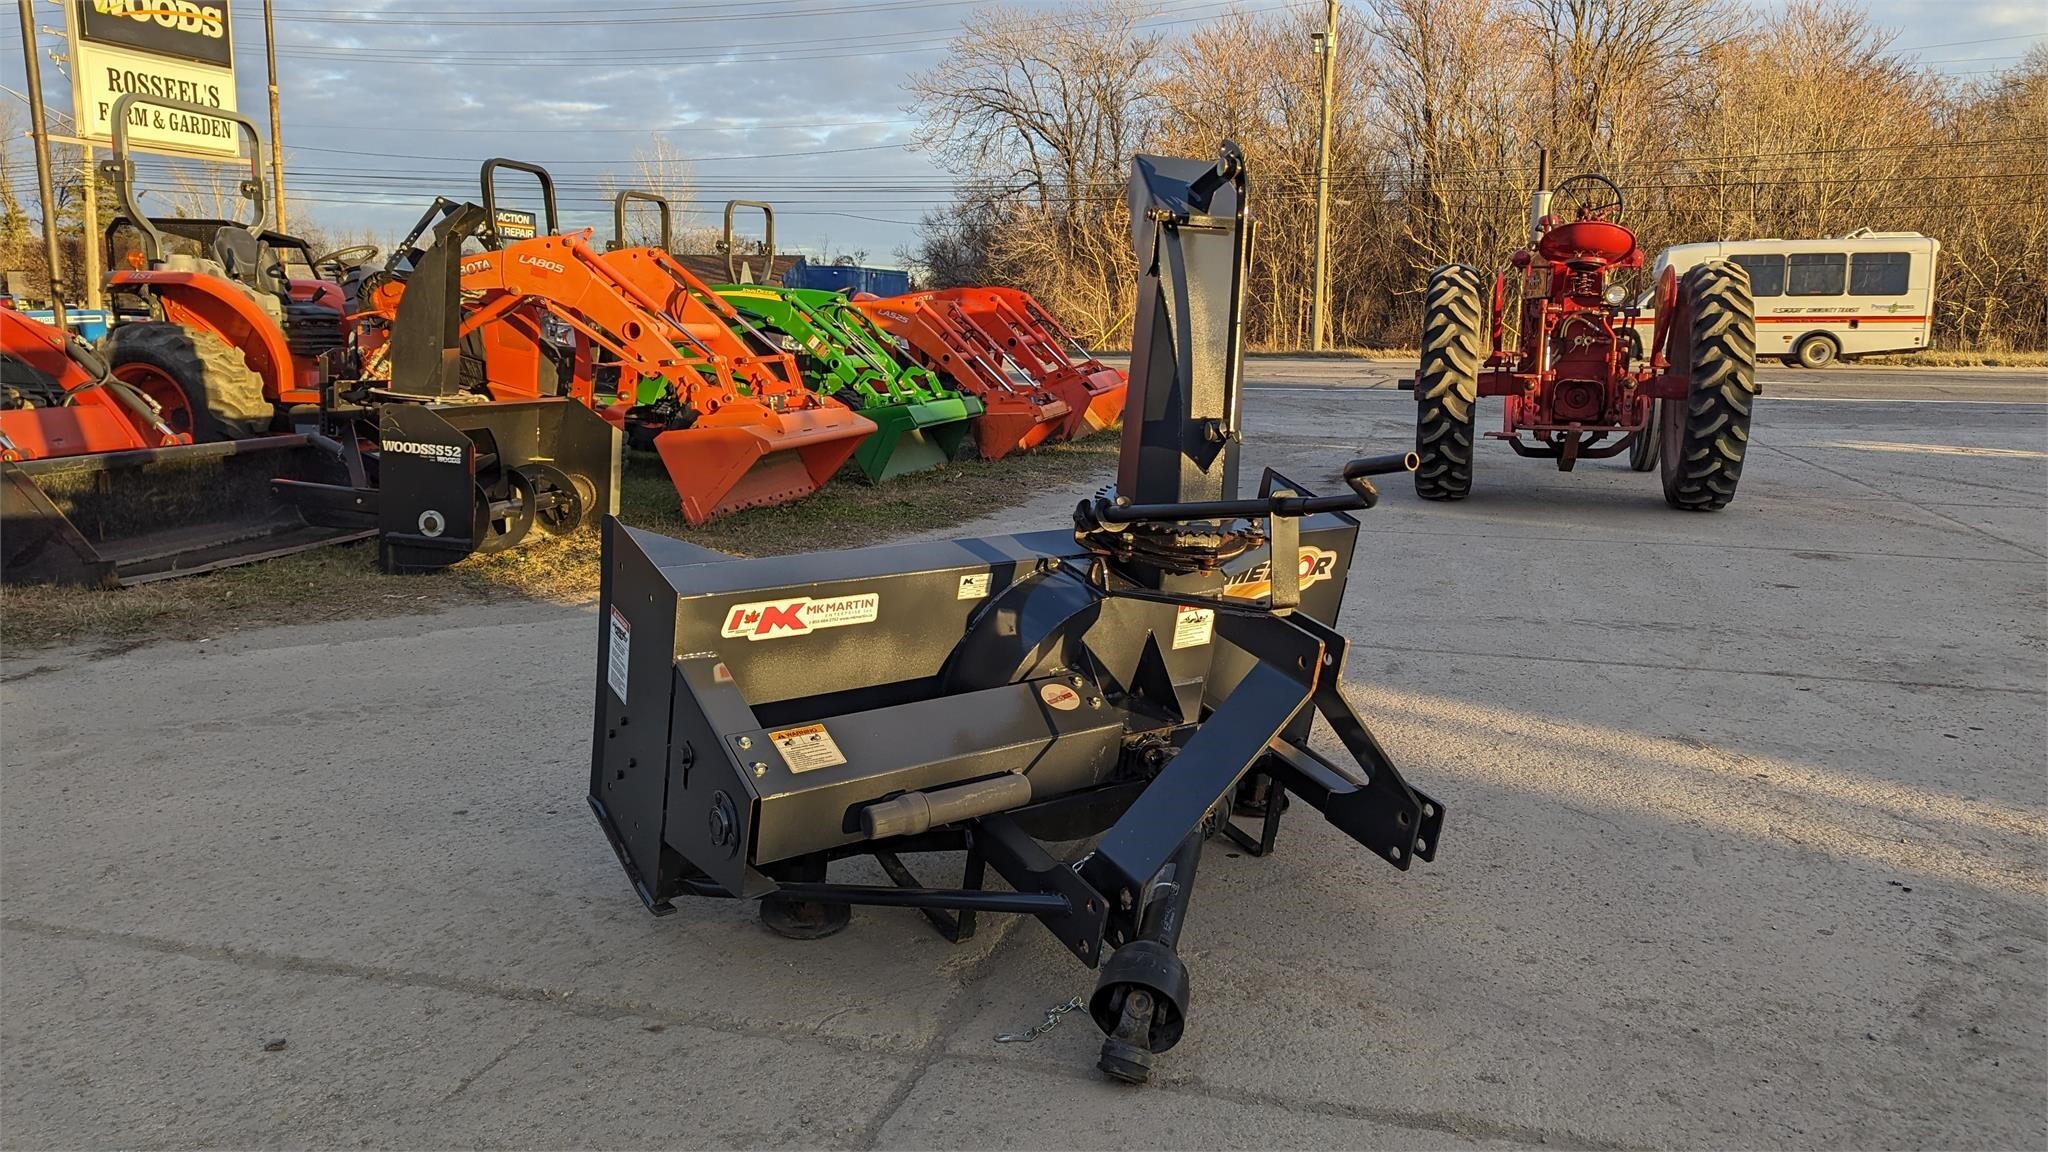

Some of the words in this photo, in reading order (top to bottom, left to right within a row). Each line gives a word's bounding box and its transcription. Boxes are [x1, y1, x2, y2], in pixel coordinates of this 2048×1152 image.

[93, 0, 224, 38] WOODS
[106, 67, 221, 109] ROSSEEL'S
[98, 101, 149, 127] FRM
[153, 110, 165, 130] &
[169, 112, 231, 139] GARDEN
[504, 226, 534, 239] REPAIR
[518, 254, 565, 274] LA805
[806, 603, 825, 616] MK
[826, 598, 875, 613] MARTIN
[786, 727, 818, 738] WARNING
